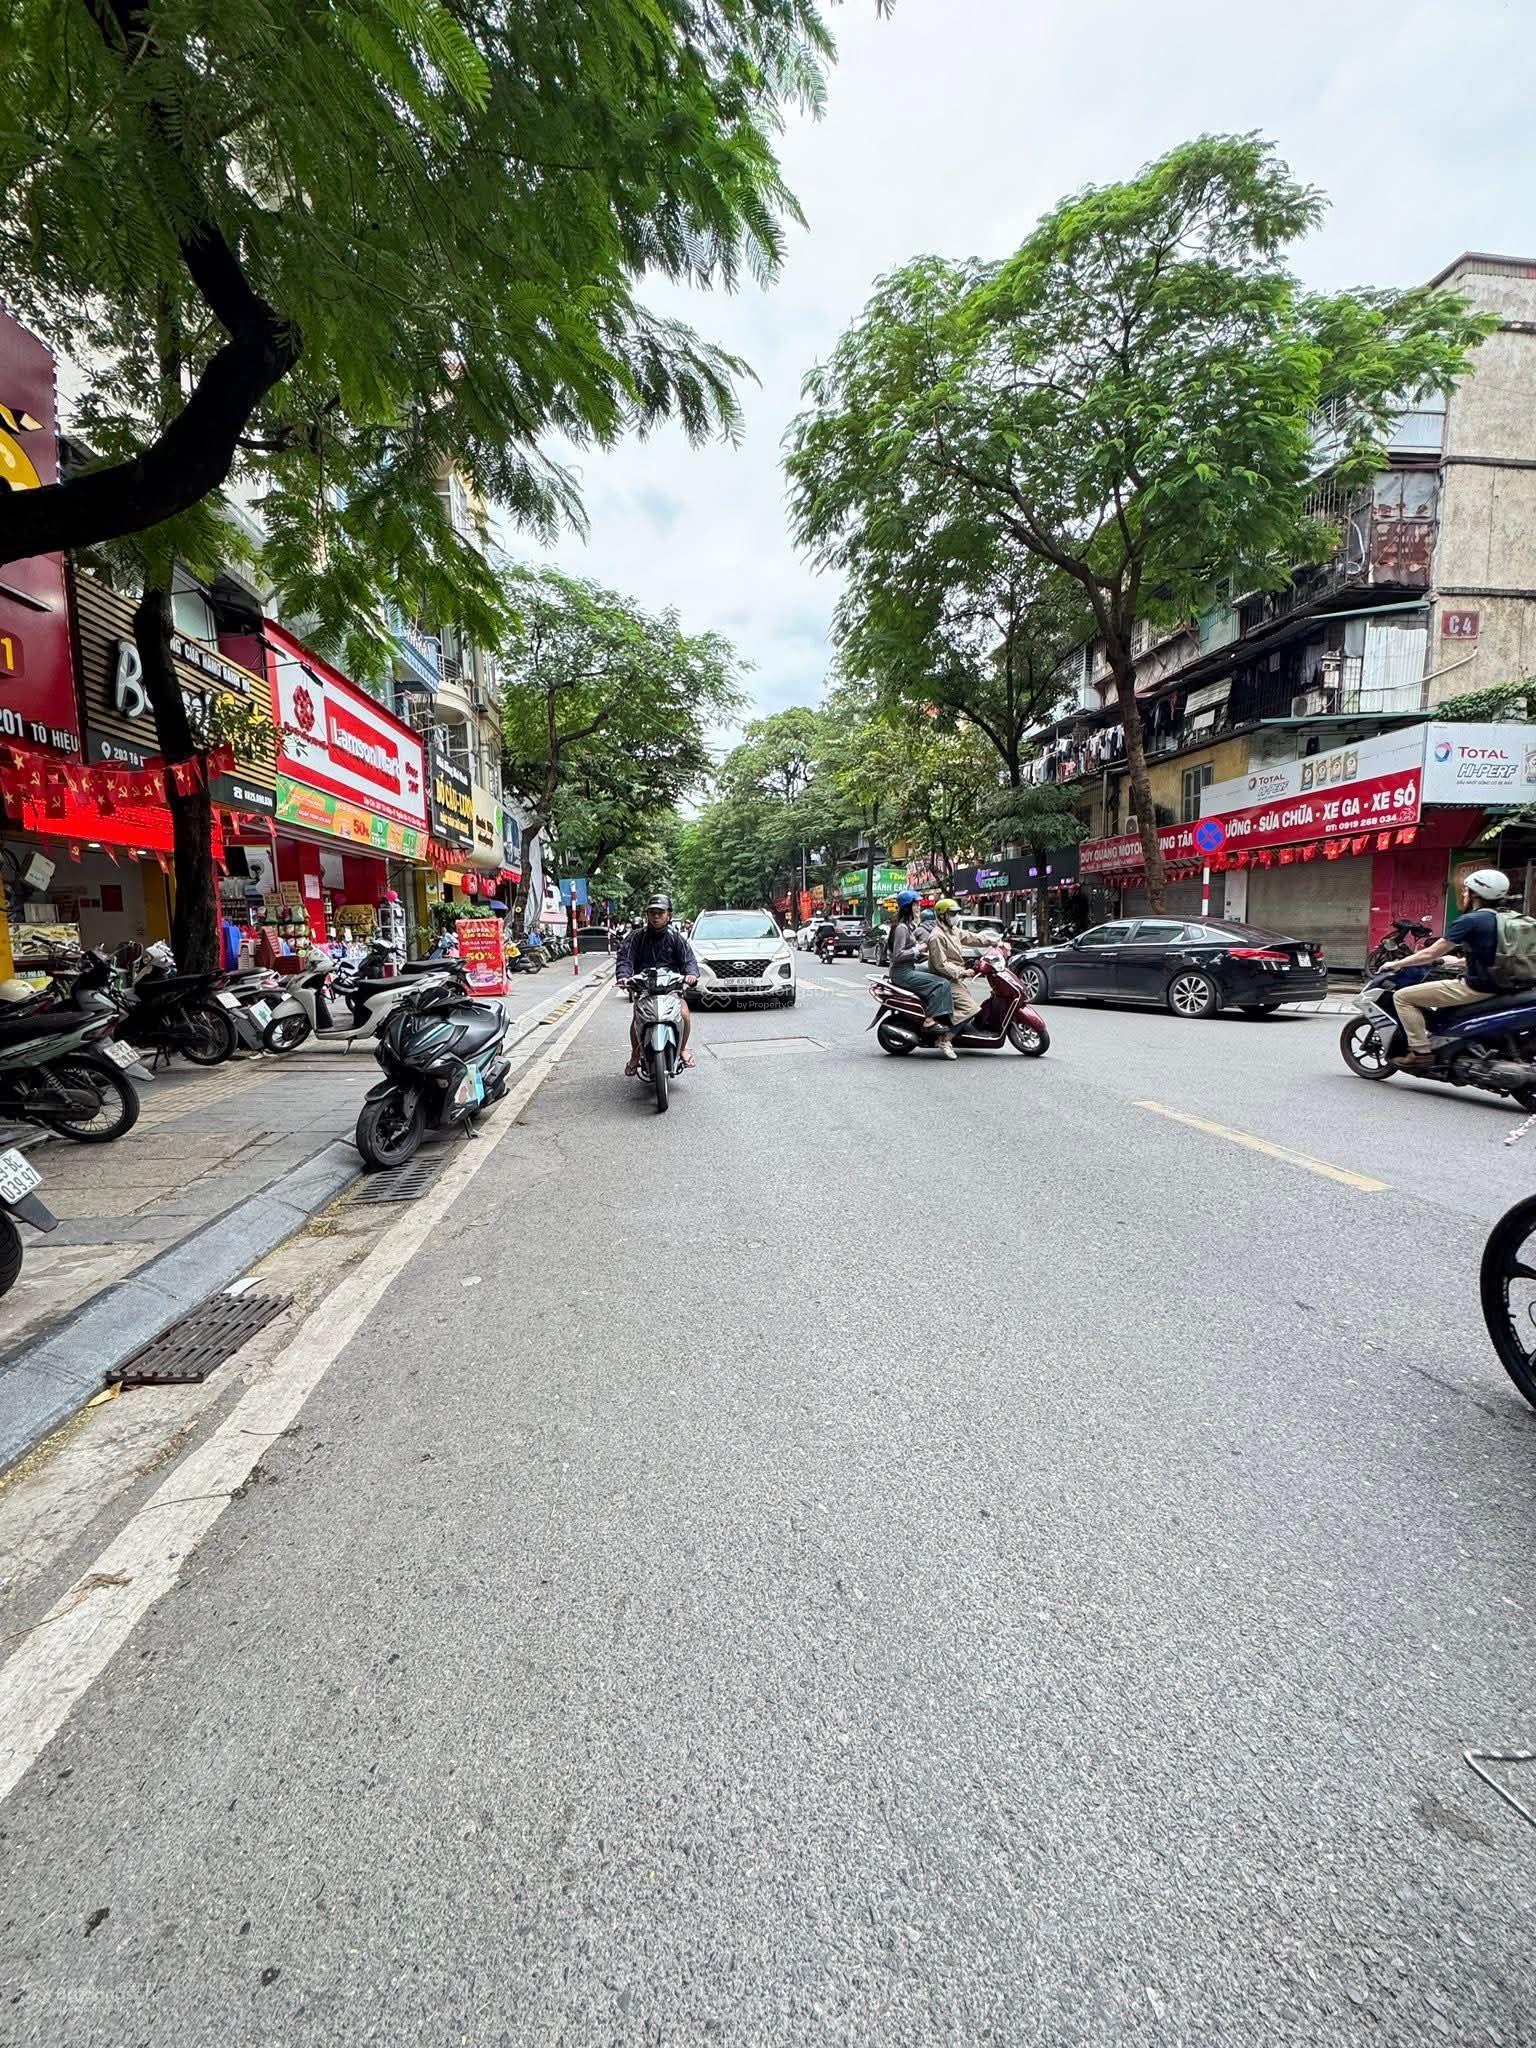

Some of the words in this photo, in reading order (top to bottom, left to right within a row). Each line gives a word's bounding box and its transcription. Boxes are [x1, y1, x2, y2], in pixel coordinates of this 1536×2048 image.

[1449, 615, 1460, 635] C
[1462, 617, 1472, 633] 4
[31, 721, 48, 744] TÔ
[51, 727, 80, 754] HIỆU
[1458, 746, 1508, 759] TOTAL
[1457, 762, 1518, 778] HI-PERF
[1258, 774, 1286, 785] TOTAL
[1225, 818, 1251, 839] ƯỠNG
[1322, 801, 1343, 821] XE
[1341, 797, 1360, 817] GA
[1370, 791, 1391, 812] XE
[1393, 779, 1417, 808] SỐ
[1378, 814, 1397, 824] 034
[1094, 844, 1118, 861] QUANG
[1158, 835, 1176, 850] UNG
[466, 951, 496, 961] 50%
